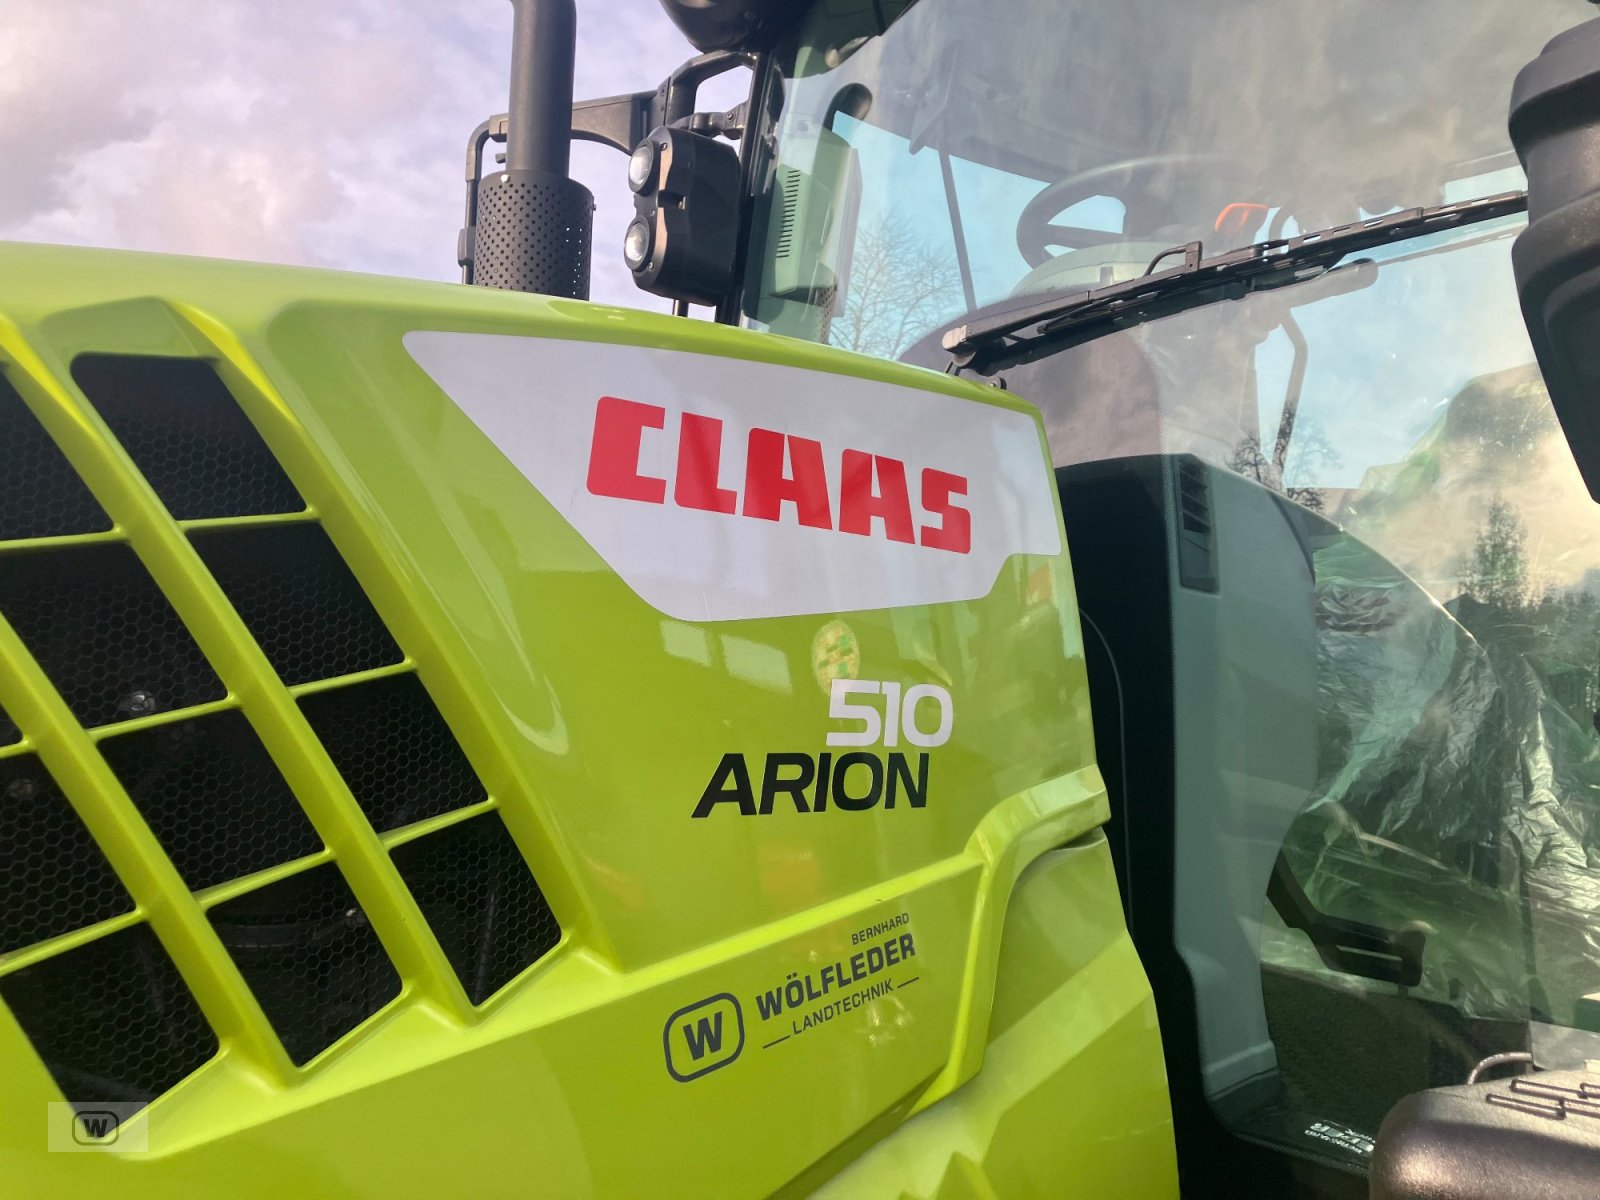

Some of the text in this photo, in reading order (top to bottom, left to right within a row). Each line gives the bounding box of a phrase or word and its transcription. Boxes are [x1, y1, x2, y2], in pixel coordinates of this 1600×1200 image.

[587, 396, 971, 554] CLAAS
[826, 678, 953, 747] 510
[691, 752, 929, 818] ARION
[851, 912, 910, 945] BERNHARD
[755, 932, 916, 1021] WÖLFLEDER
[792, 978, 894, 1035] LANDTECHNIK
[683, 1011, 723, 1061] W
